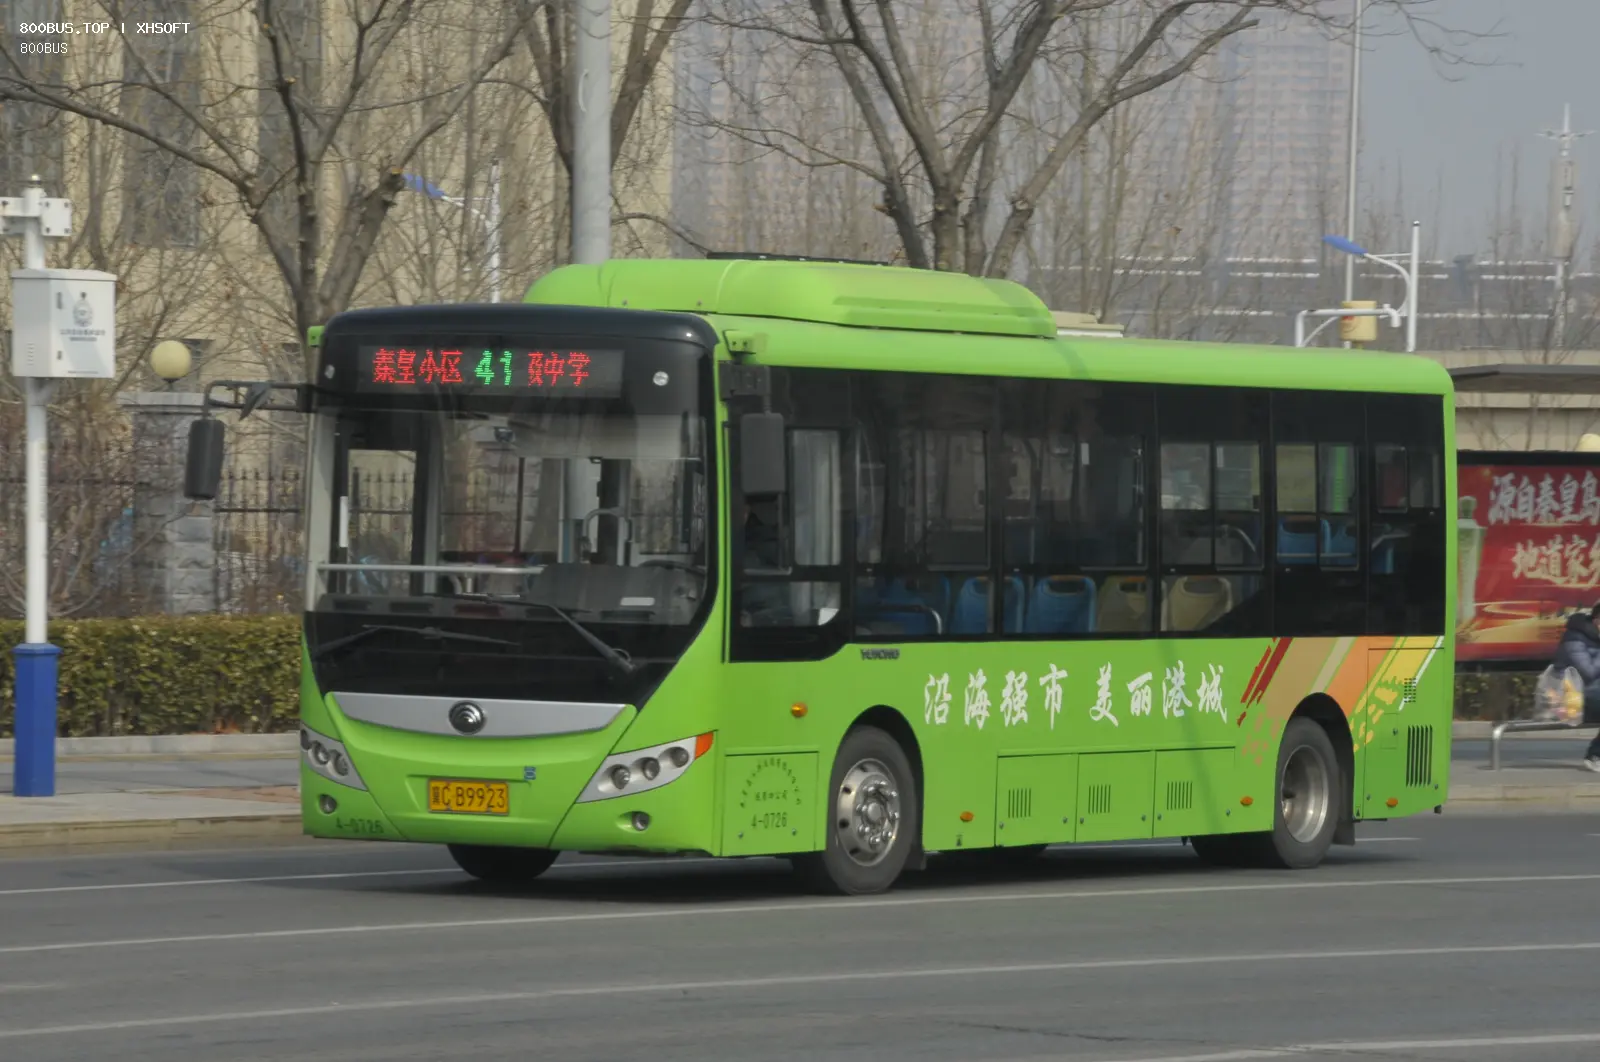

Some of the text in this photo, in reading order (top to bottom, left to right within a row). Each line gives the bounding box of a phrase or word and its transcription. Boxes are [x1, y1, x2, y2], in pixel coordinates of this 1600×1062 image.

[372, 348, 464, 385] 秦皇小区
[474, 350, 512, 386] 41
[924, 660, 1228, 731] 沿海强市 美丽港城
[751, 811, 788, 829] 4-0726
